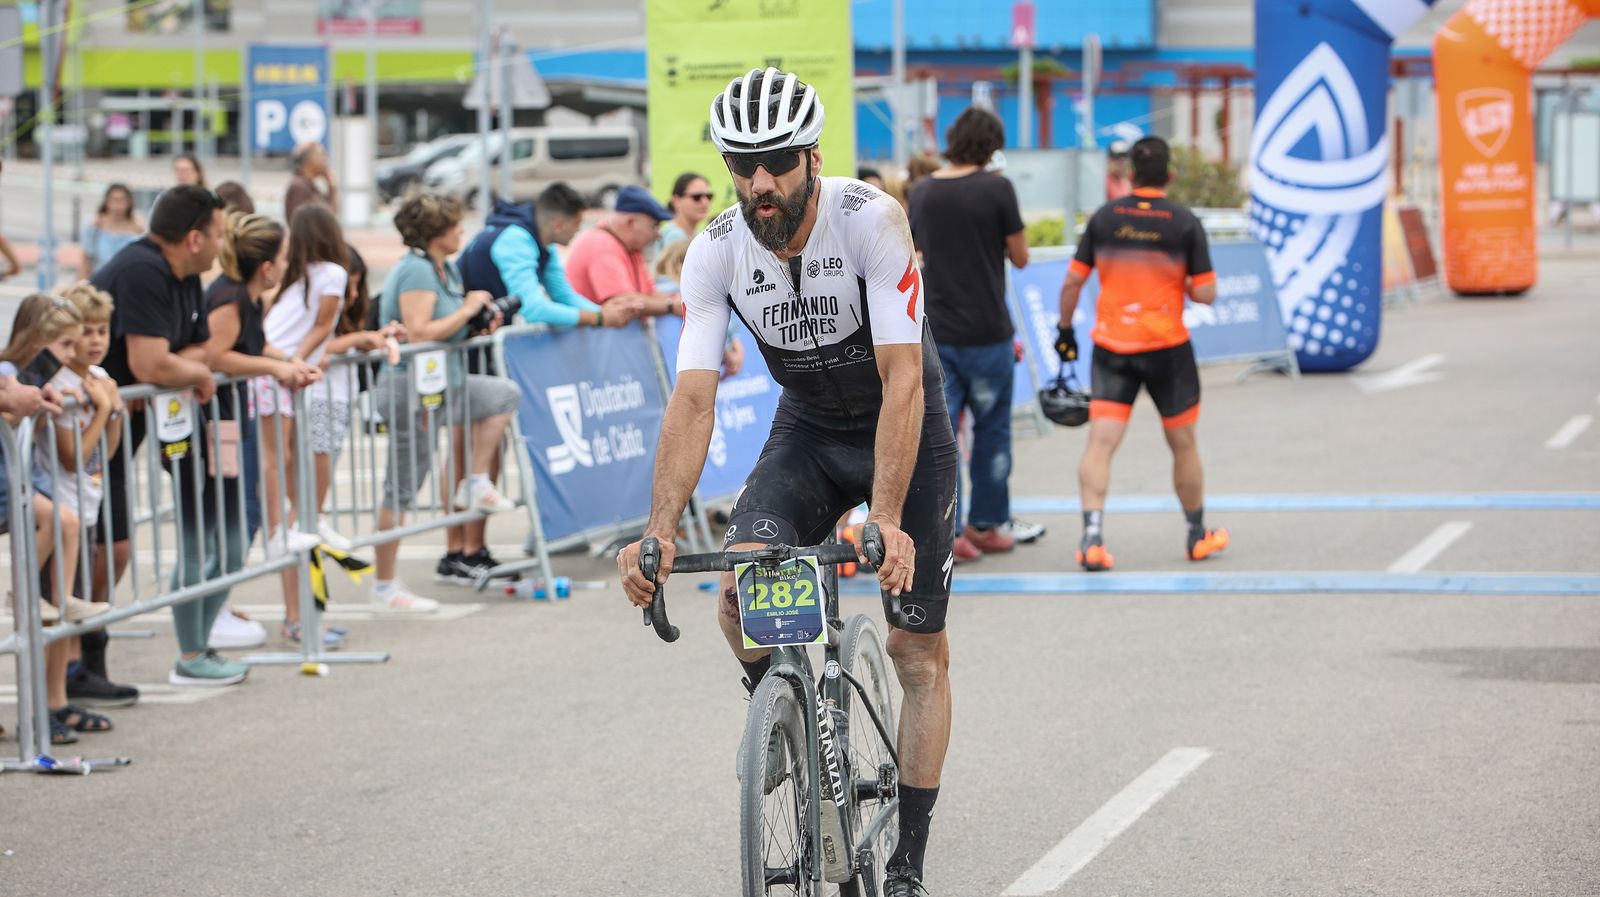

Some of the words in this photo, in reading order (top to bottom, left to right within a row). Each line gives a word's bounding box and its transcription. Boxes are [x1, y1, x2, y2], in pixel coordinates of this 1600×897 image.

[840, 194, 867, 211] TORRES
[702, 207, 738, 236] RNANDO
[708, 219, 734, 241] TORRES
[823, 257, 843, 270] LEO
[823, 269, 845, 278] GRUPO
[745, 283, 777, 297] VIATOR
[763, 295, 839, 329] FERNANDO
[778, 317, 838, 345] TORRES
[578, 373, 646, 419] Diputación
[591, 430, 612, 466] de
[608, 422, 647, 462] Cádiz
[747, 580, 816, 611] 282
